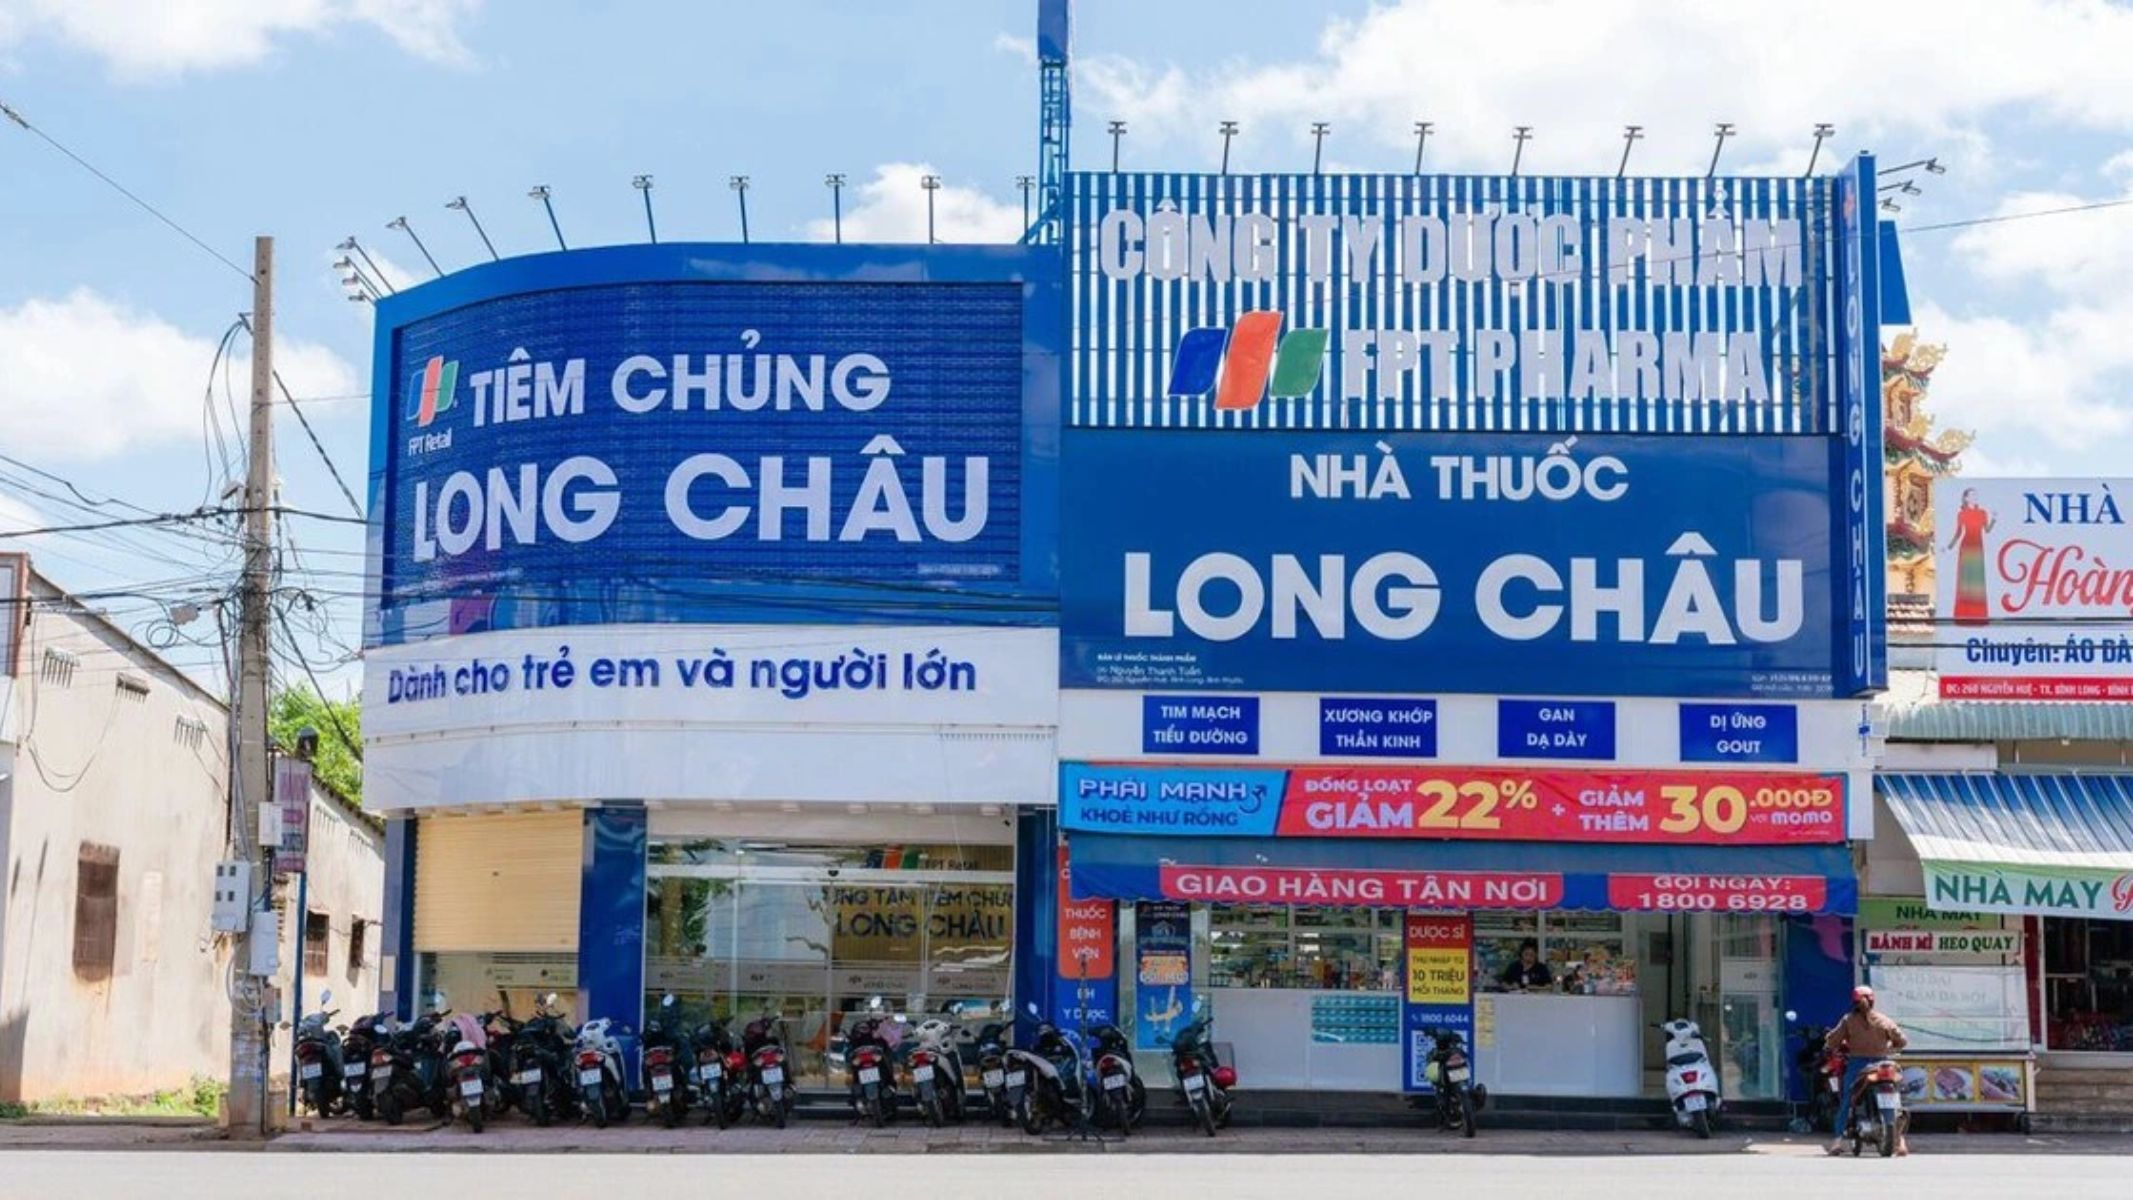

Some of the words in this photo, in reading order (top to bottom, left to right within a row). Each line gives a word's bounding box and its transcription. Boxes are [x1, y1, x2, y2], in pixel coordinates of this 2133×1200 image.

[1100, 200, 1273, 283] CÔNG
[1297, 212, 1384, 284] TY
[1402, 204, 1583, 297] DƯỢC
[1608, 190, 1803, 288] PHẨM
[1846, 244, 1863, 447] LONG
[1343, 328, 1456, 397] FPT
[1474, 330, 1769, 400] PHARMA
[470, 347, 586, 428] TIÊM
[611, 329, 892, 413] CHỦNG
[408, 435, 424, 457] FPT
[424, 427, 453, 452] Retail
[1289, 440, 1411, 501] NHÀ
[1431, 435, 1630, 502] THUỐC
[413, 455, 621, 563] LONG
[664, 434, 989, 542] CHÂU
[2023, 483, 2125, 524] NHÀ
[1998, 539, 2133, 613] Hoàn
[1124, 549, 1442, 642] LONG
[1475, 531, 1804, 646] CHÂU
[1966, 636, 2060, 666] Chuyên:
[2064, 633, 2095, 663] ÁO
[388, 662, 446, 704] Dành
[455, 658, 510, 695] cho
[523, 645, 574, 690] trẻ
[590, 658, 660, 688] em
[676, 648, 735, 689] và
[749, 647, 889, 701] người
[903, 648, 977, 691] lớn
[1160, 705, 1189, 719] TIM
[1192, 705, 1241, 723] MẠCH
[1323, 707, 1384, 723] XƯƠNG
[1387, 706, 1433, 724] KHỚP
[1538, 708, 1575, 722] GAN
[1710, 714, 1727, 732] DỊ
[1730, 711, 1767, 730] ỨNG
[1152, 723, 1187, 744] TIỂU
[1189, 723, 1249, 745] ĐƯỜNG
[1335, 731, 1379, 749] THẦN
[1382, 734, 1421, 749] KINH
[1526, 732, 1550, 750] DẠ
[1551, 729, 1588, 748] DÀY
[1717, 739, 1762, 754] GOUT
[1078, 776, 1147, 801] PHÁI
[1160, 781, 1247, 806] MẠNH
[1304, 775, 1360, 794] ĐỒNG
[1363, 778, 1411, 798] LOẠT
[1578, 784, 1645, 808] GIẢM
[1305, 792, 1414, 830] GIẢM
[1416, 778, 1537, 830] 22%
[1136, 809, 1180, 826] NHƯ
[1578, 811, 1650, 832] THÊM
[1771, 810, 1833, 825] momo
[1176, 874, 1268, 897] GIAO
[1277, 868, 1385, 900] HÀNG
[1396, 872, 1471, 904] TẬN
[1484, 878, 1547, 902] NƠI
[1653, 875, 1705, 895] GỌI
[1710, 877, 1792, 891] NGAY:
[1935, 870, 2013, 907] NHÀ
[2024, 878, 2103, 910] MAY
[1064, 904, 1107, 919] THUỐC
[1638, 893, 1717, 909] 1800
[1727, 894, 1808, 910] 6928
[836, 913, 917, 937] LONG
[928, 908, 1004, 940] CHÂU
[1409, 925, 1450, 942] DƯỢC
[1870, 932, 1913, 950] BÁNH
[1916, 931, 1934, 949] MÌ
[1938, 937, 1970, 949] HEO
[1971, 937, 2014, 952] QUAY
[1412, 969, 1426, 982] 10
[1430, 967, 1465, 984] TRIỆU
[1073, 1007, 1109, 1022] DỢC,
[1420, 1012, 1443, 1024] 1800
